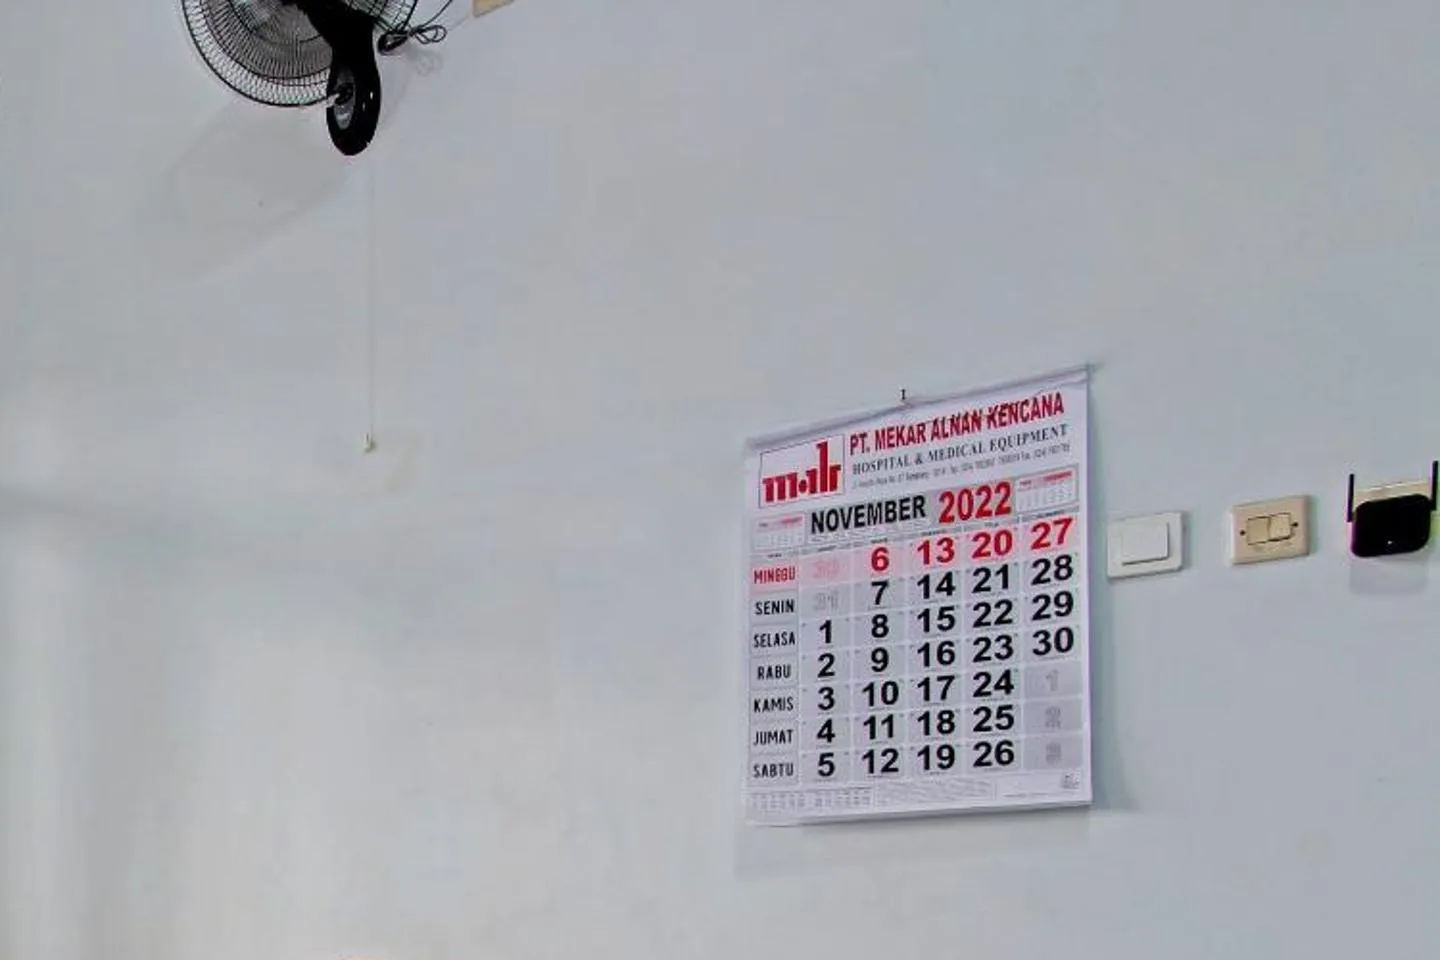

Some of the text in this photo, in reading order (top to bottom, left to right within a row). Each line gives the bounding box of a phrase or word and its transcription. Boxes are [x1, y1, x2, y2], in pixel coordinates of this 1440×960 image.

[850, 391, 1065, 456] PT. MEKAR ALNAN KENCANA
[852, 452, 911, 475] HOSPITAL
[928, 440, 984, 463] MEDICAL
[989, 423, 1068, 451] EQUIPMENT
[811, 494, 926, 535] NOVEMBER
[938, 481, 1013, 525] 2022
[871, 546, 889, 571] 6
[917, 537, 955, 565] 13
[972, 529, 1013, 559] 20
[1031, 517, 1073, 550] 27
[755, 599, 794, 615] SENIN
[871, 580, 889, 605] 7
[917, 571, 956, 599] 14
[972, 563, 1009, 594] 21
[1031, 554, 1074, 586] 28
[753, 590, 1074, 648] SELASA 1 8 15 22 29
[757, 627, 1074, 680] RABU 2 9 16 23 30
[753, 696, 794, 713] KAMIS
[817, 686, 835, 711] 3
[861, 681, 899, 707] 10
[917, 675, 955, 702] 17
[972, 669, 1014, 698] 24
[753, 729, 794, 746] JUMAT
[816, 718, 836, 743] 4
[863, 714, 894, 740] 11
[917, 709, 955, 736] 18
[972, 704, 1015, 732] 25
[753, 763, 794, 778] SABTU
[817, 752, 835, 777] 5
[862, 748, 899, 774] 12
[917, 744, 956, 771] 19
[972, 739, 1015, 768] 26
